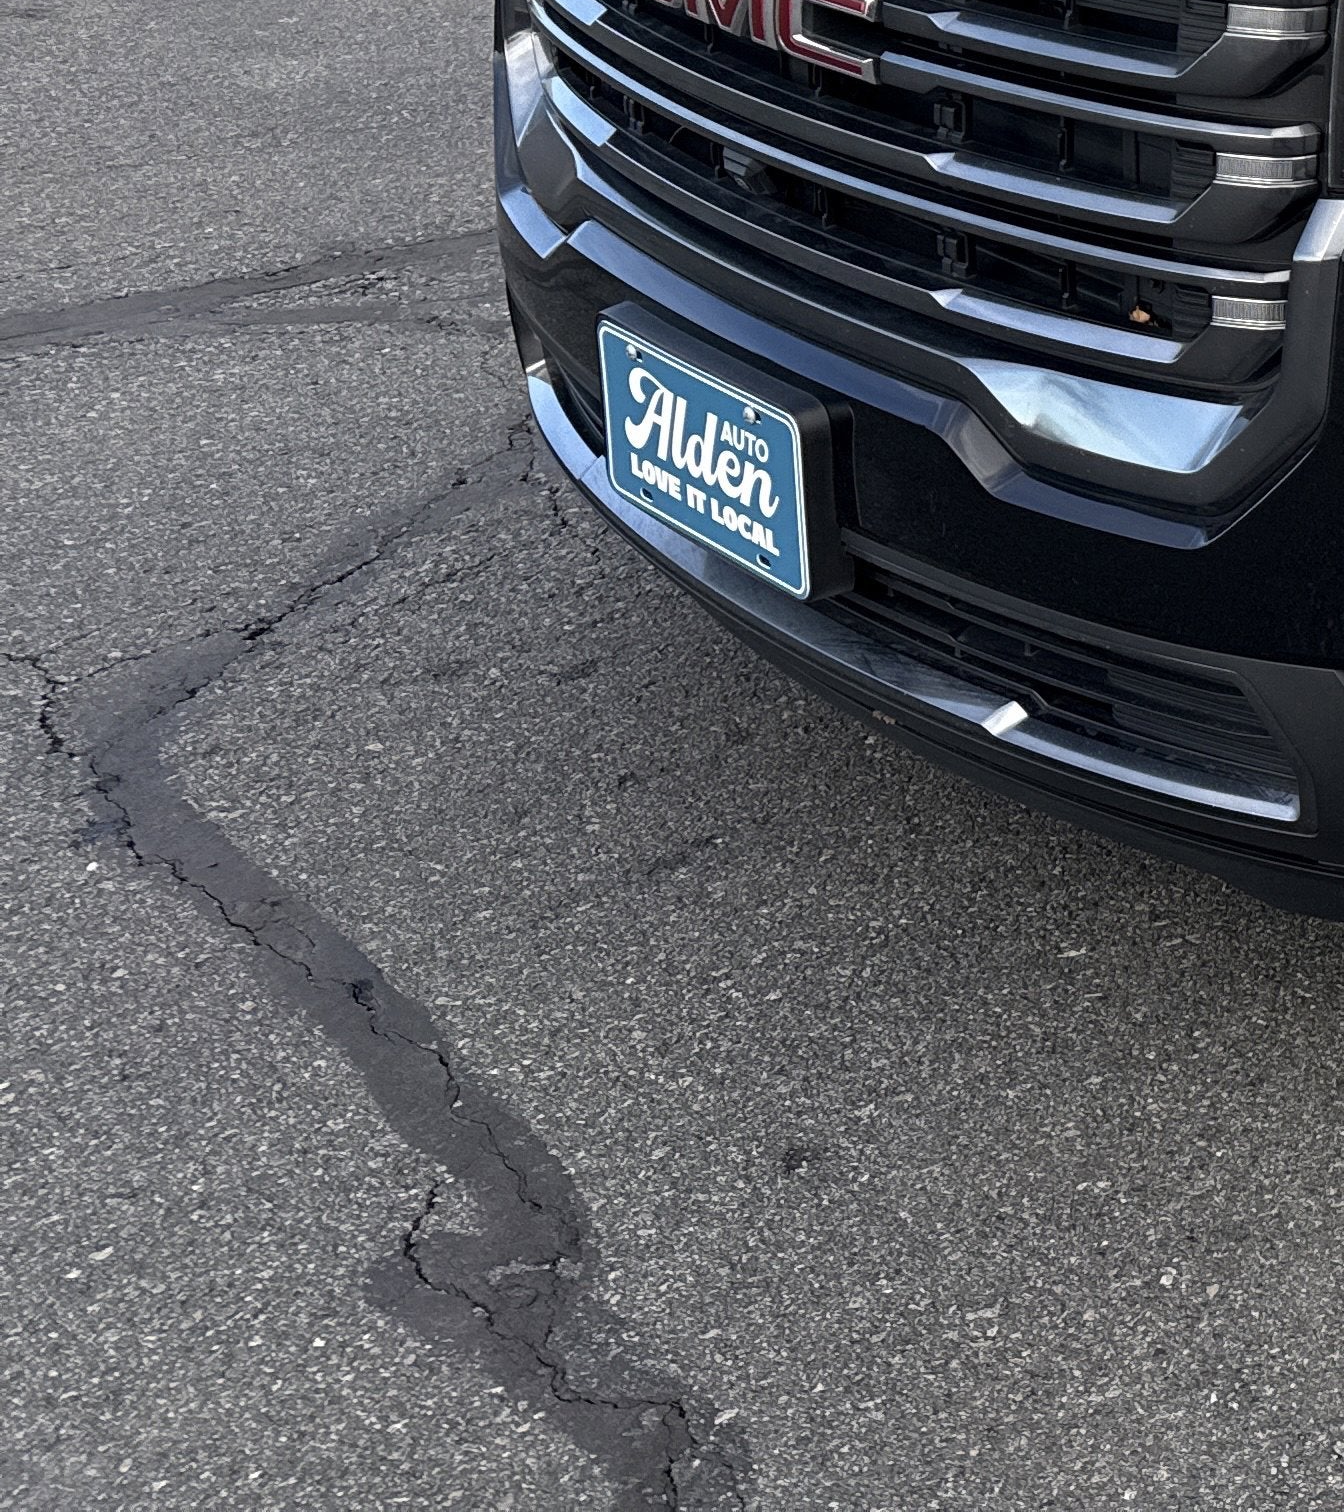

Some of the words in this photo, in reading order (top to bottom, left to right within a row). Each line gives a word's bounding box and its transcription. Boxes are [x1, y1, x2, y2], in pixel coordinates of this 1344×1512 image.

[624, 367, 780, 518] Alden
[720, 421, 769, 462] AUTO
[630, 452, 682, 502] LOVE
[686, 483, 707, 514] IT
[711, 498, 780, 557] LOCAL
